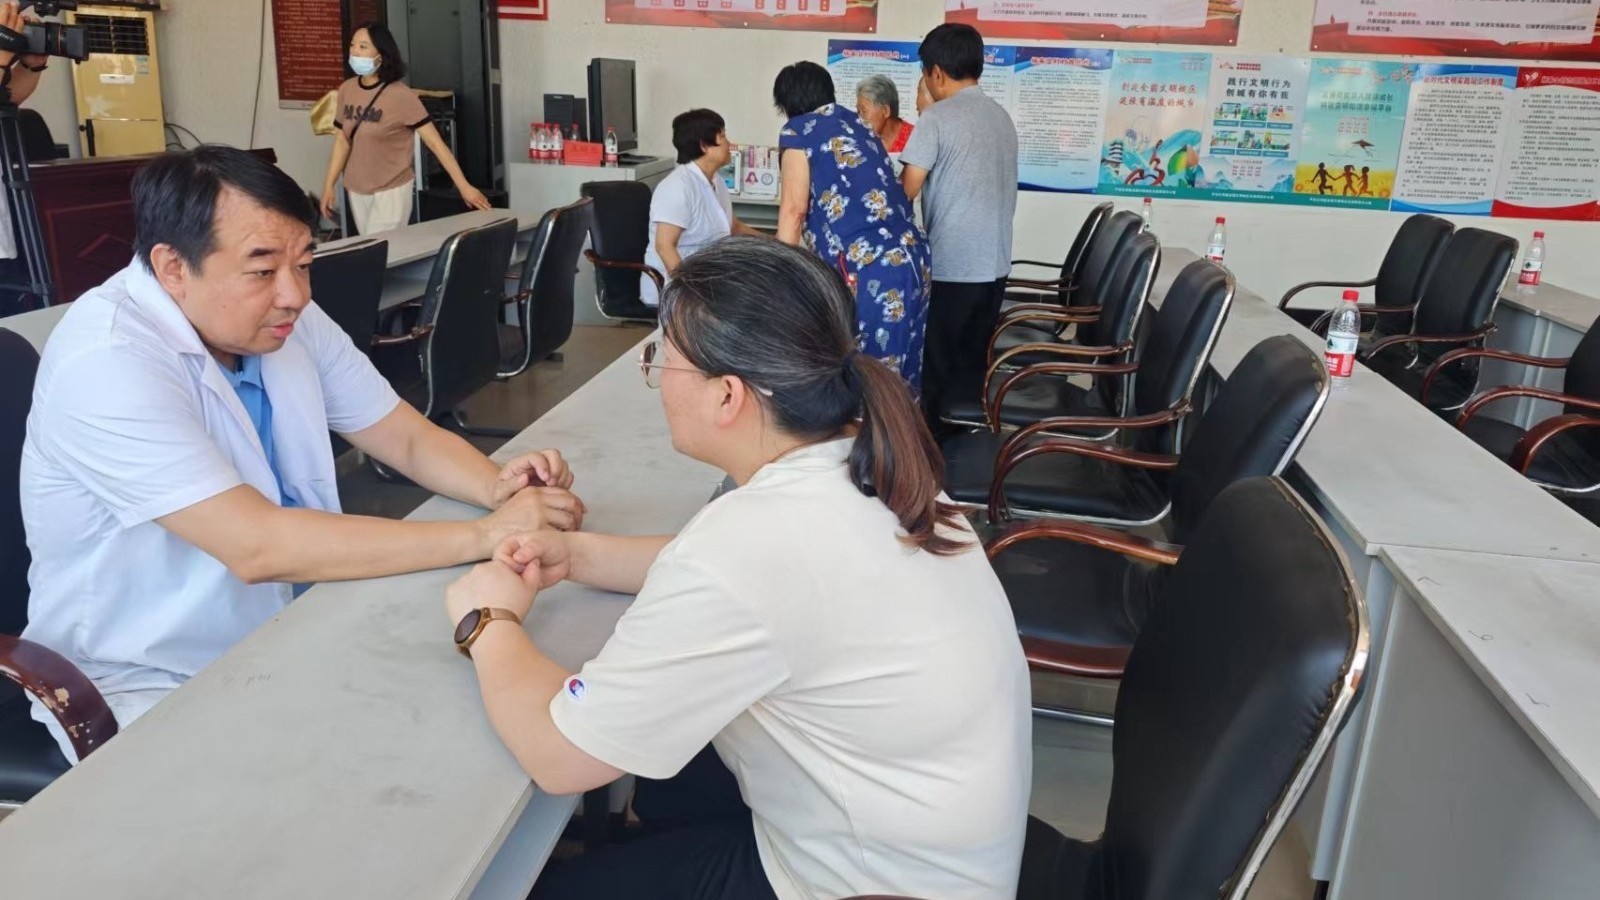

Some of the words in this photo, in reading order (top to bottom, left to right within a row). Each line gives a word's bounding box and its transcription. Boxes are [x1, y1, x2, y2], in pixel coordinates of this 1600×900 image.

[1227, 77, 1291, 89] 践行文明行为
[1226, 88, 1289, 100] 创城有你有我
